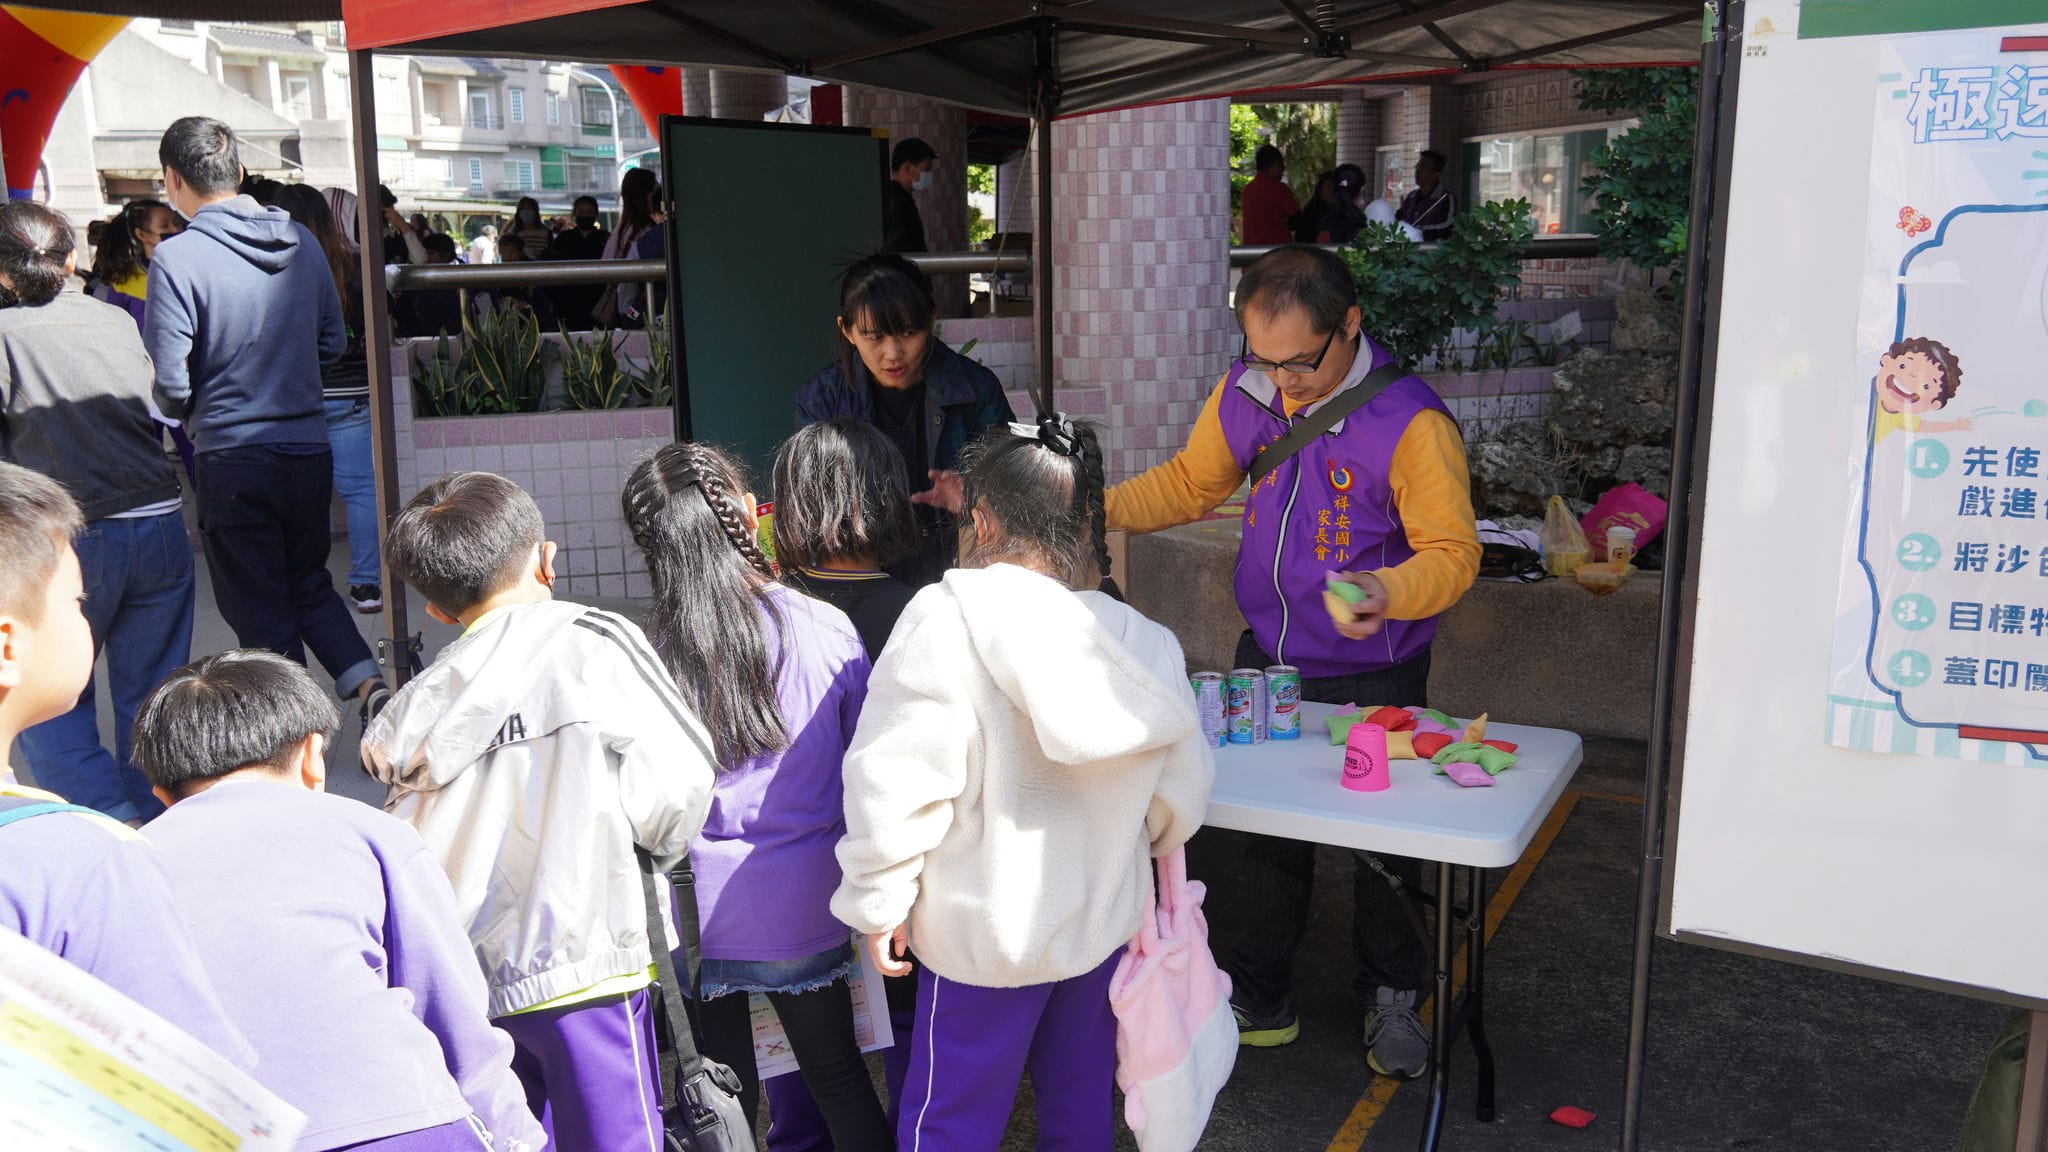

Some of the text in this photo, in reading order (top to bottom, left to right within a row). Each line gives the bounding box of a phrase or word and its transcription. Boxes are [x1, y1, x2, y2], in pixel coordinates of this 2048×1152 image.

[1905, 64, 2048, 144] 極速
[1911, 445, 2048, 478] 1. 先使
[1957, 484, 2048, 520] 戲進
[1313, 508, 1331, 561] 家長會
[1333, 493, 1352, 563] 祥安國小
[1901, 539, 1934, 564] 2.
[1896, 600, 1929, 624] 3.
[1892, 655, 1925, 679] 4.
